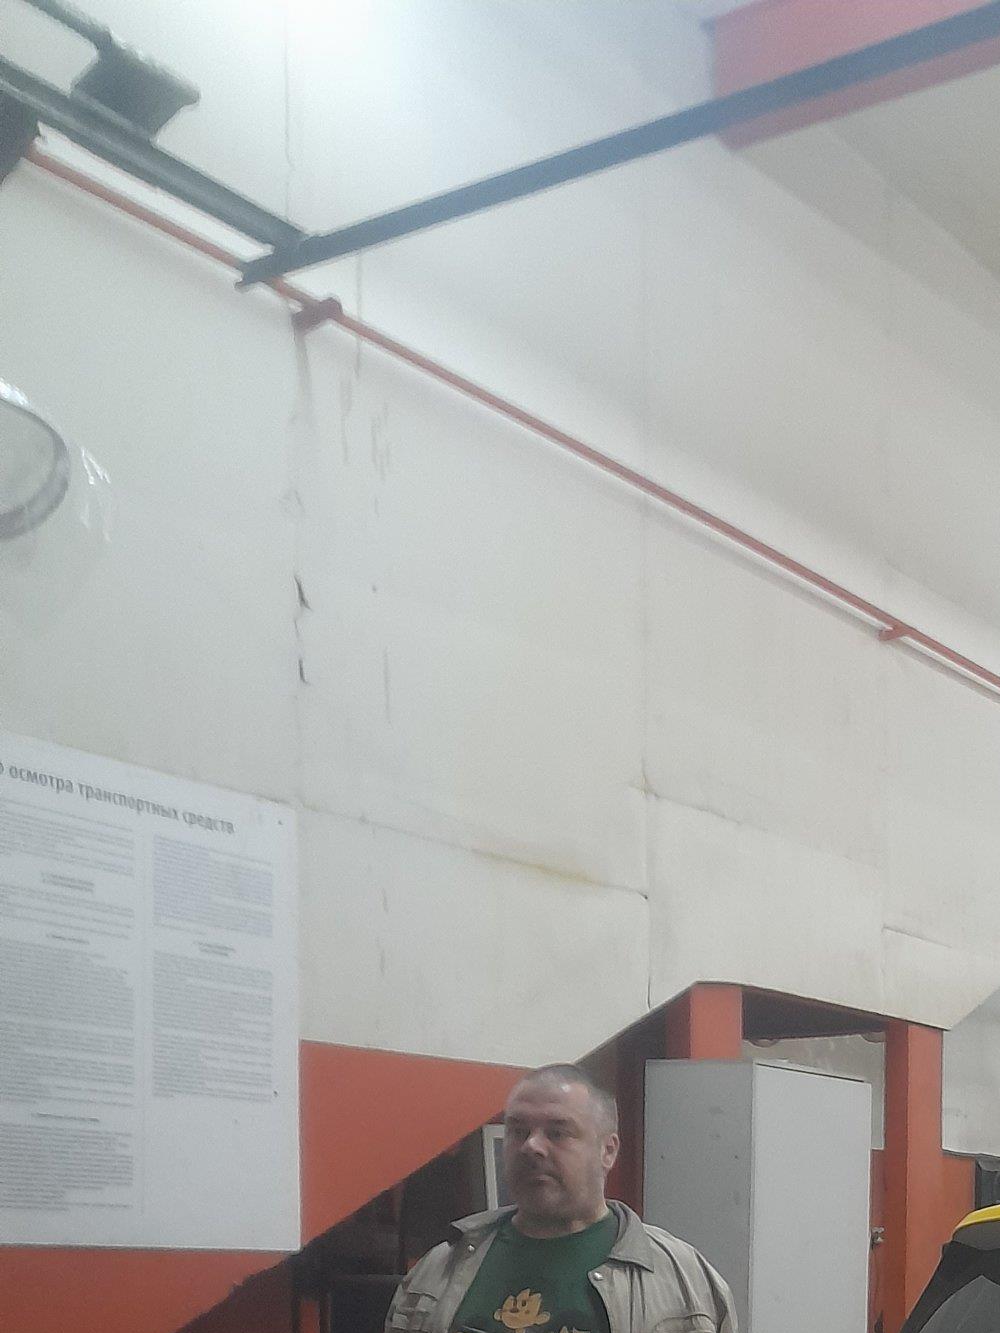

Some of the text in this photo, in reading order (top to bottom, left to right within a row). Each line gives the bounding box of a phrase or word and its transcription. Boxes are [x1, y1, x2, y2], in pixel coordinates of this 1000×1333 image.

[9, 765, 74, 793] осмотра
[78, 783, 179, 821] транспортных
[182, 812, 235, 834] средств
